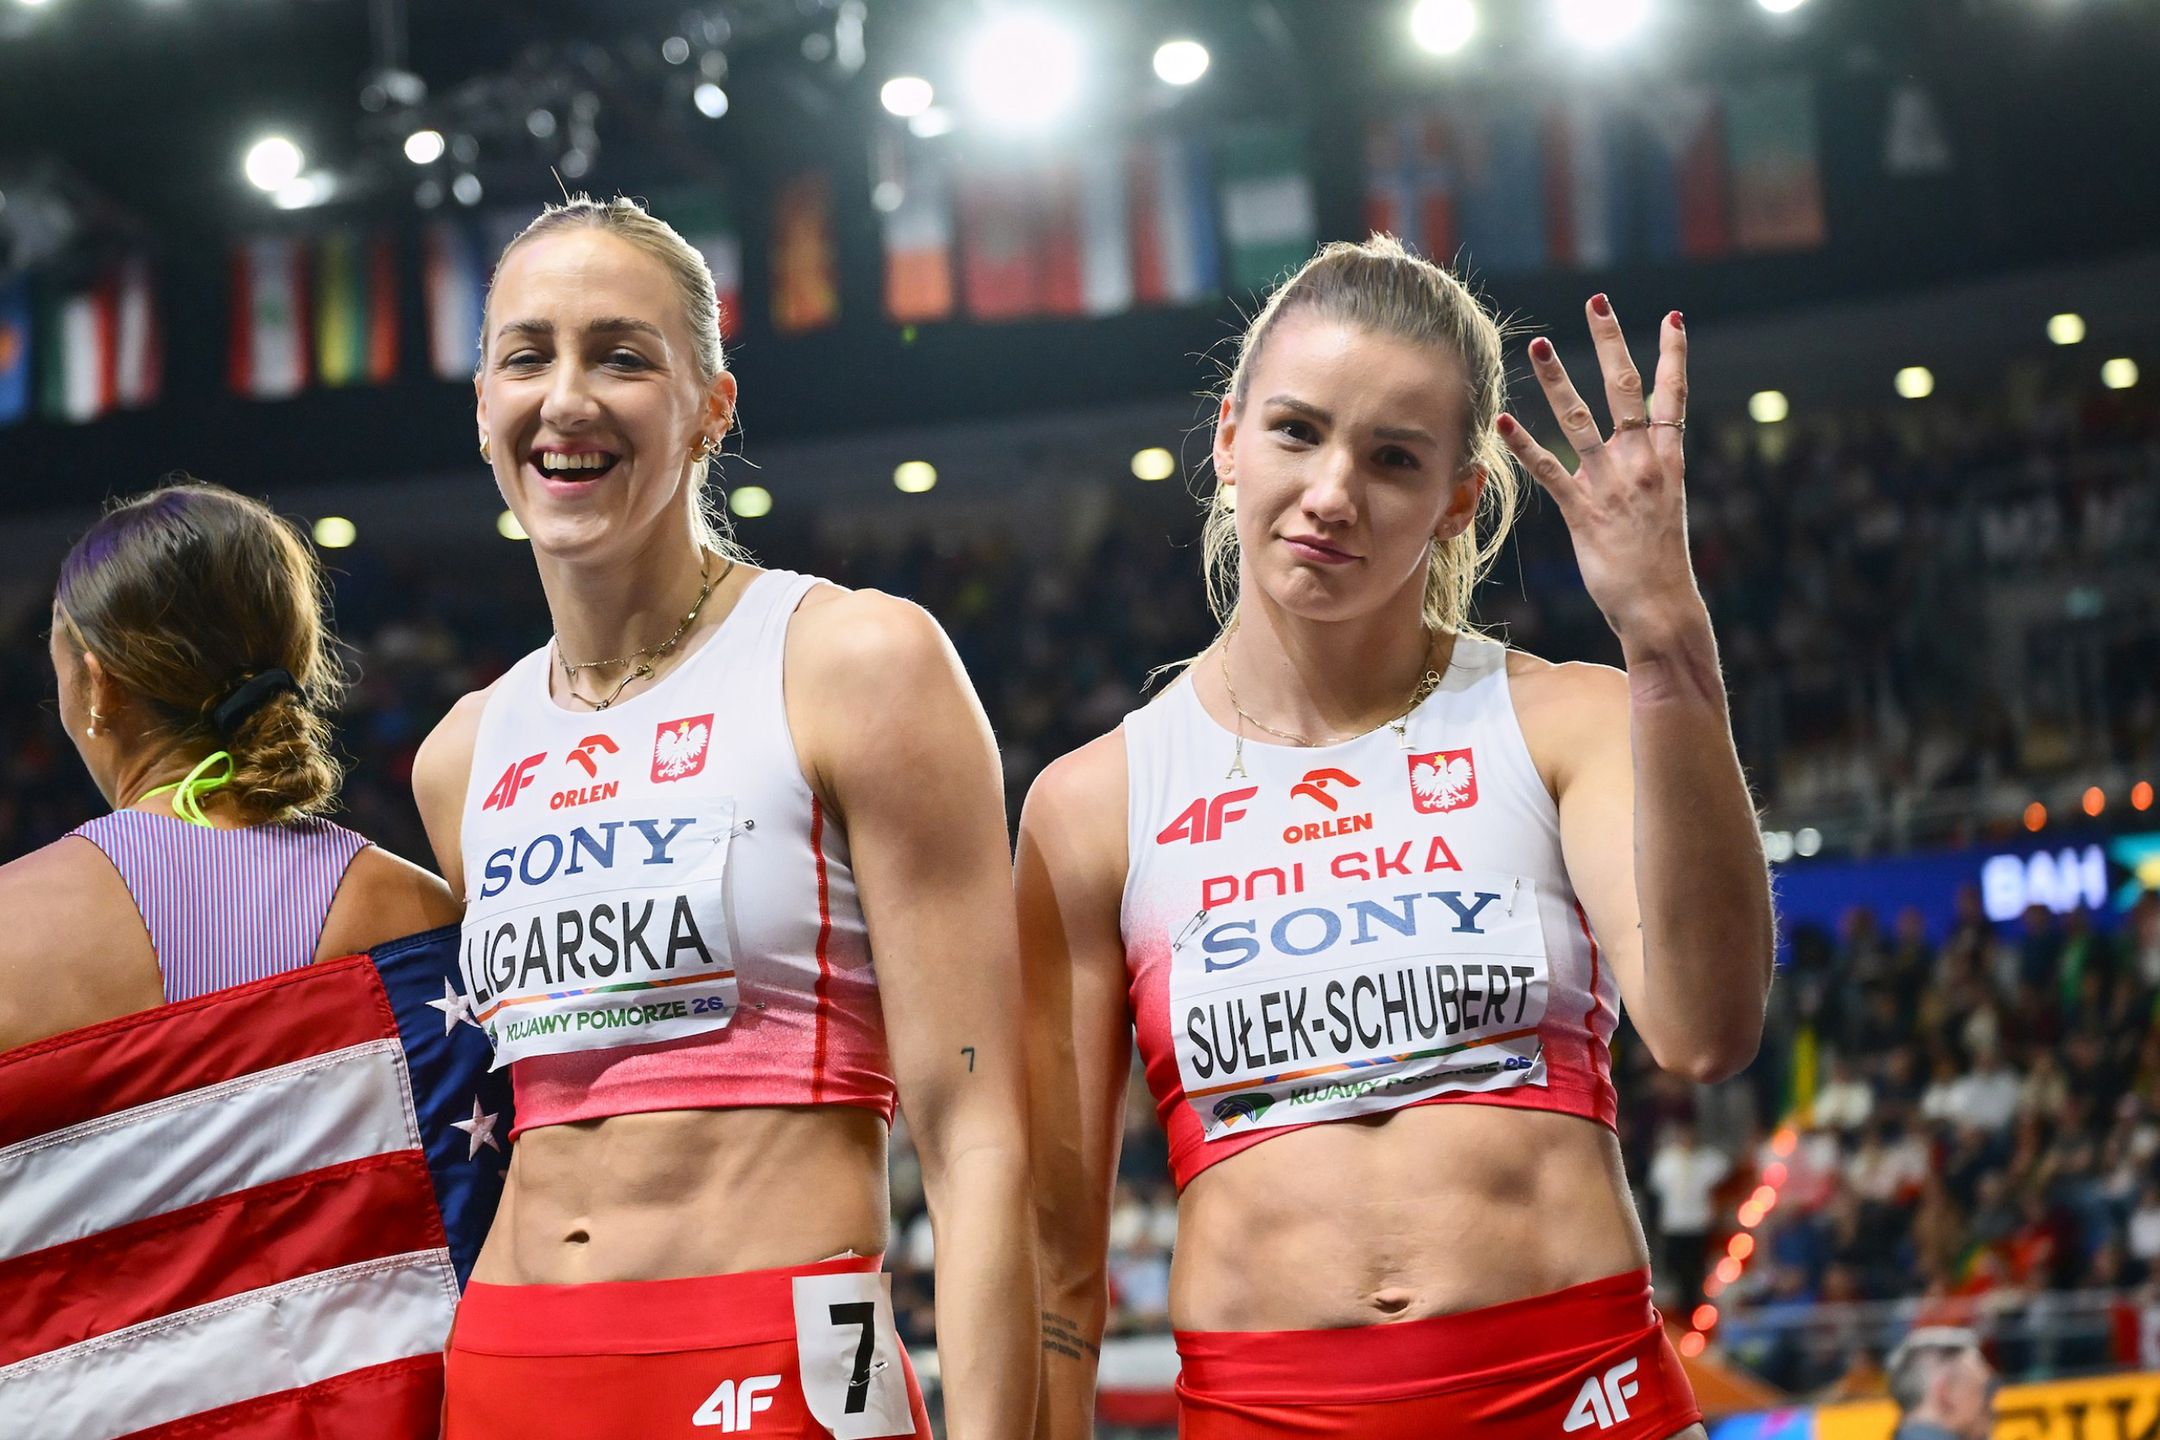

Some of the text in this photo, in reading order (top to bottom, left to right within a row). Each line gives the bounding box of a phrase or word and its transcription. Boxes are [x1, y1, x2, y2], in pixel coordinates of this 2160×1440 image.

[482, 752, 548, 811] 4F
[549, 781, 619, 810] ORLEN
[1156, 785, 1258, 845] 4F
[1282, 812, 1373, 844] ORLEN
[480, 817, 697, 900] SONY
[466, 894, 714, 1005] LIGARSKA
[1202, 890, 1501, 973] SONY
[506, 996, 725, 1043] KUJAWY POMORZE 26
[1185, 965, 1535, 1079] SUŁEK-SCHUBERT
[960, 1047, 975, 1073] 7
[1289, 1079, 1381, 1106] KUJAWY
[829, 1302, 875, 1414] 7
[692, 1374, 782, 1433] 4F
[1562, 1356, 1639, 1433] 4F
